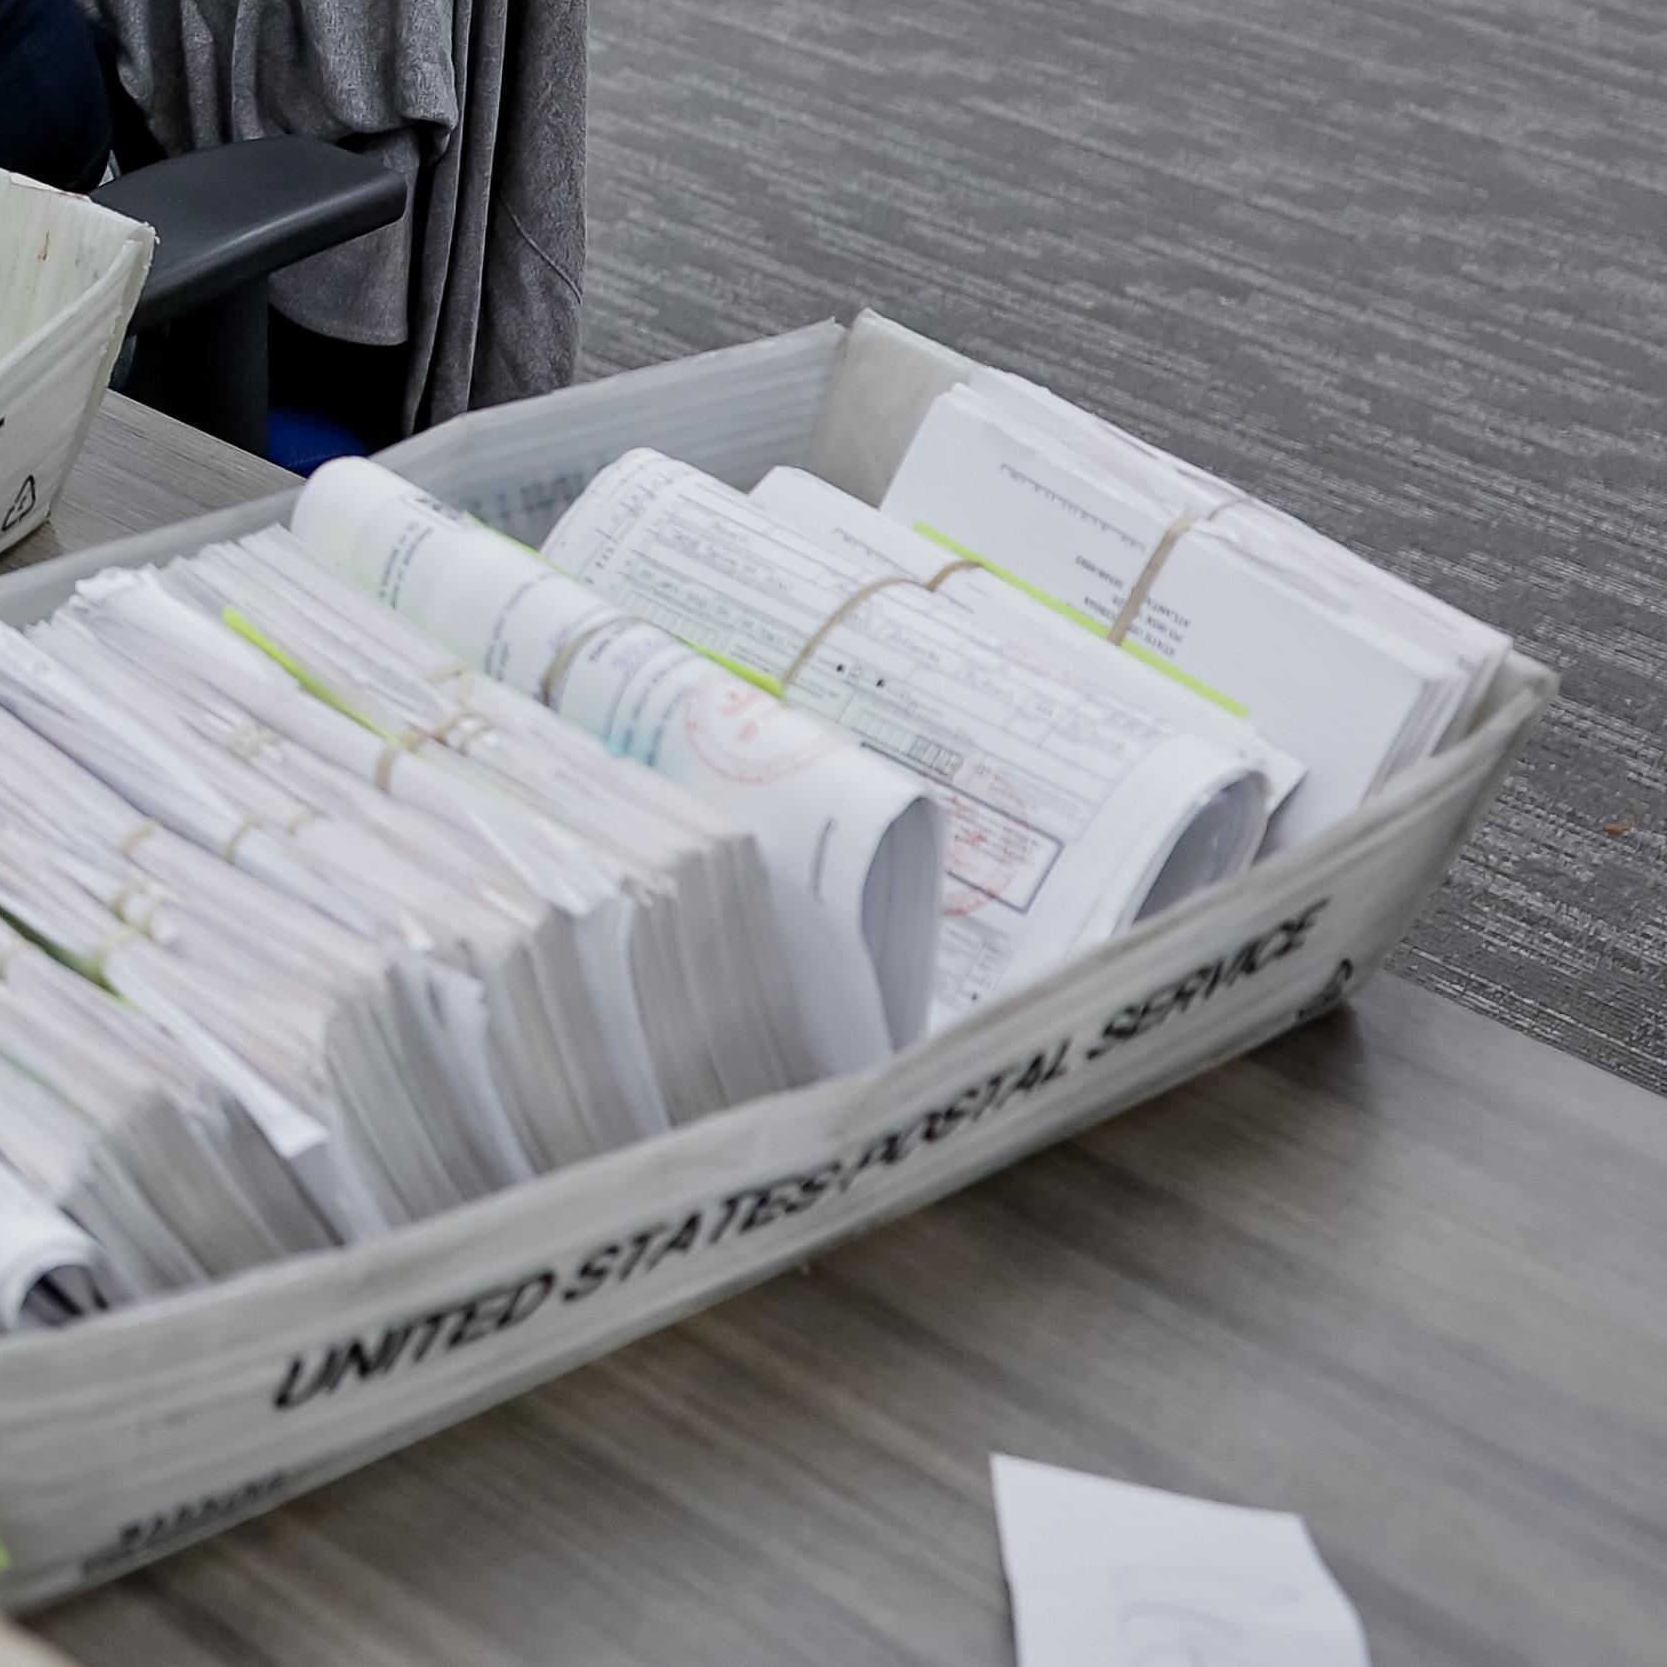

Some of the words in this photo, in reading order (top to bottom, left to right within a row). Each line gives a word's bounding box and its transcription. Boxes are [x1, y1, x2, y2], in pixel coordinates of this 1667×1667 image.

[272, 1270, 553, 1411] UNITED
[561, 1173, 843, 1305] STATES
[839, 1039, 1075, 1191] POSTAL
[1086, 898, 1329, 1064] SERVICE
